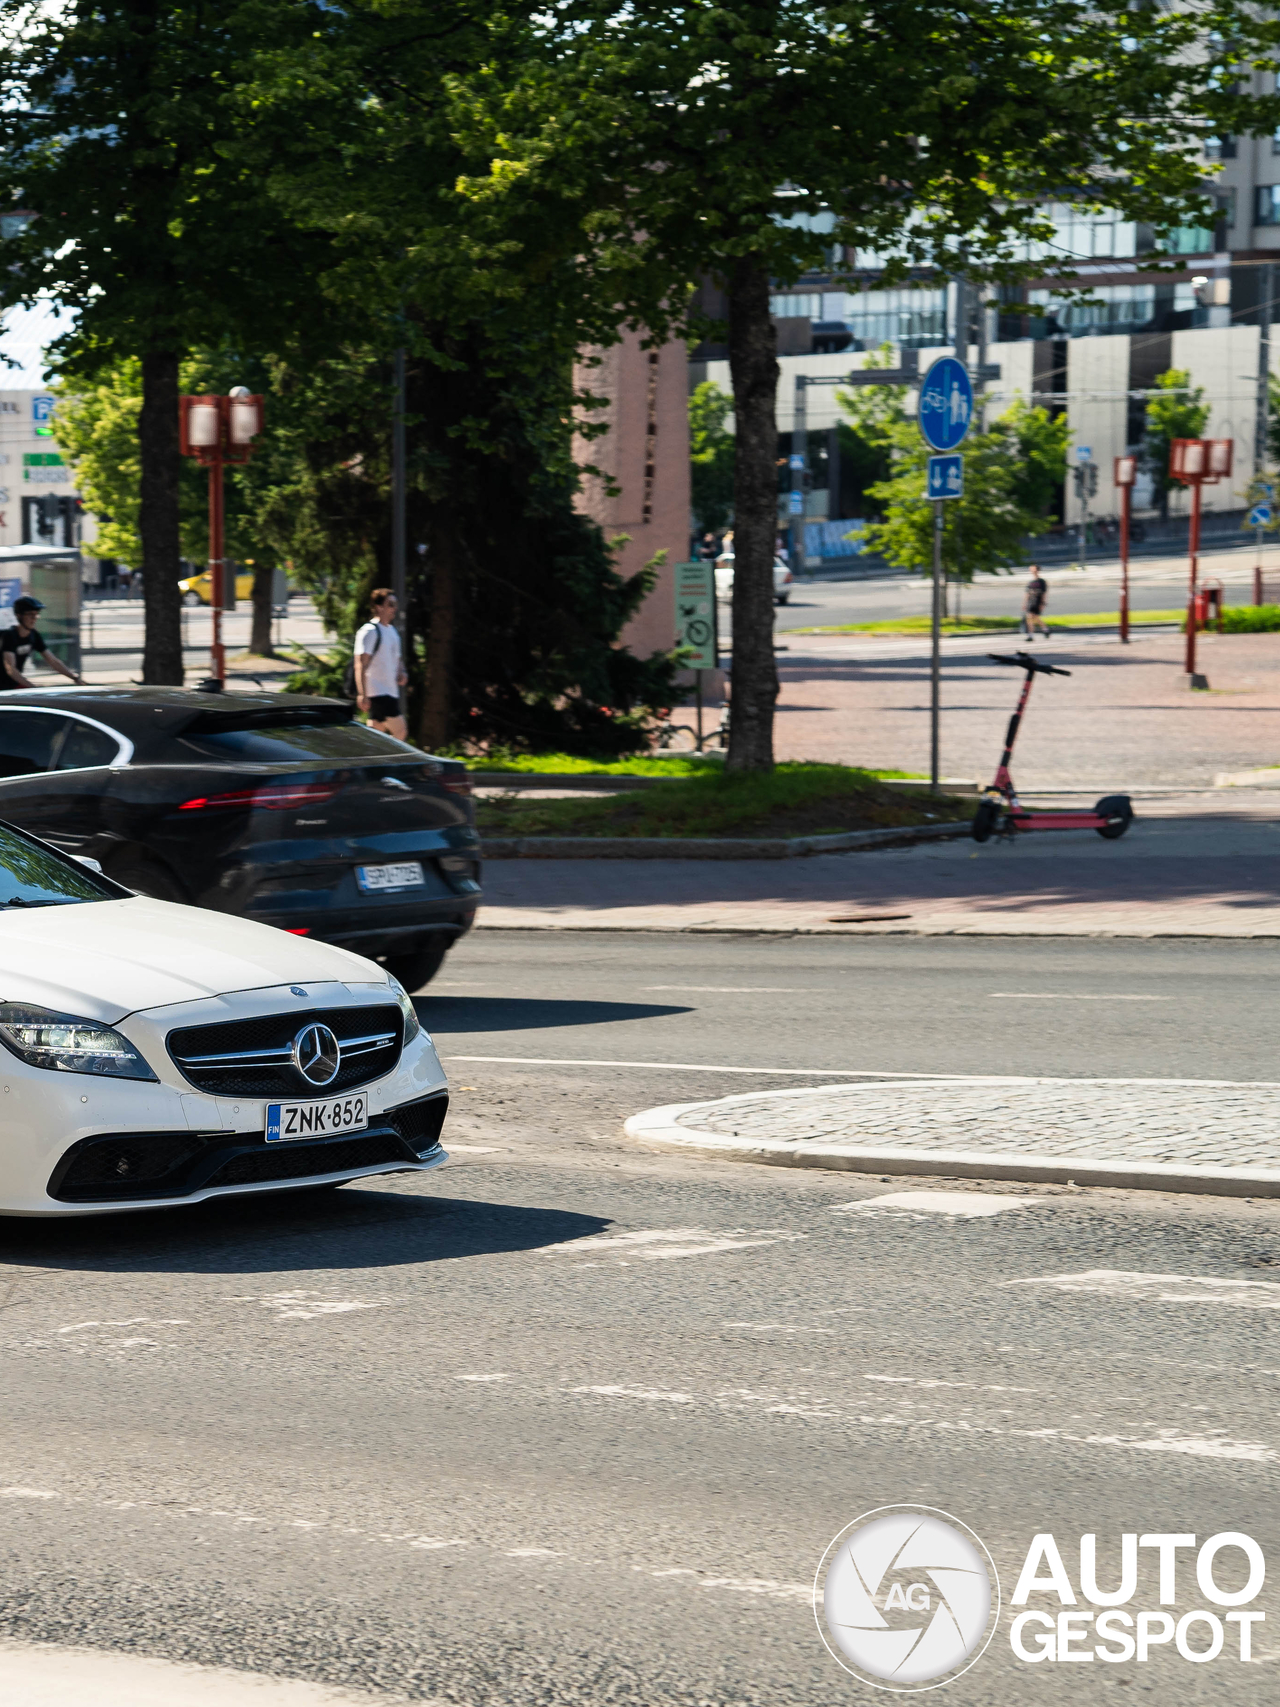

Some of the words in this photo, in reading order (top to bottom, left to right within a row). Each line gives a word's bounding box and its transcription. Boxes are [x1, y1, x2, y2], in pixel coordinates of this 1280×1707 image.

[0, 588, 11, 606] F
[285, 1098, 364, 1134] ZNK-852
[268, 1126, 280, 1134] FIN
